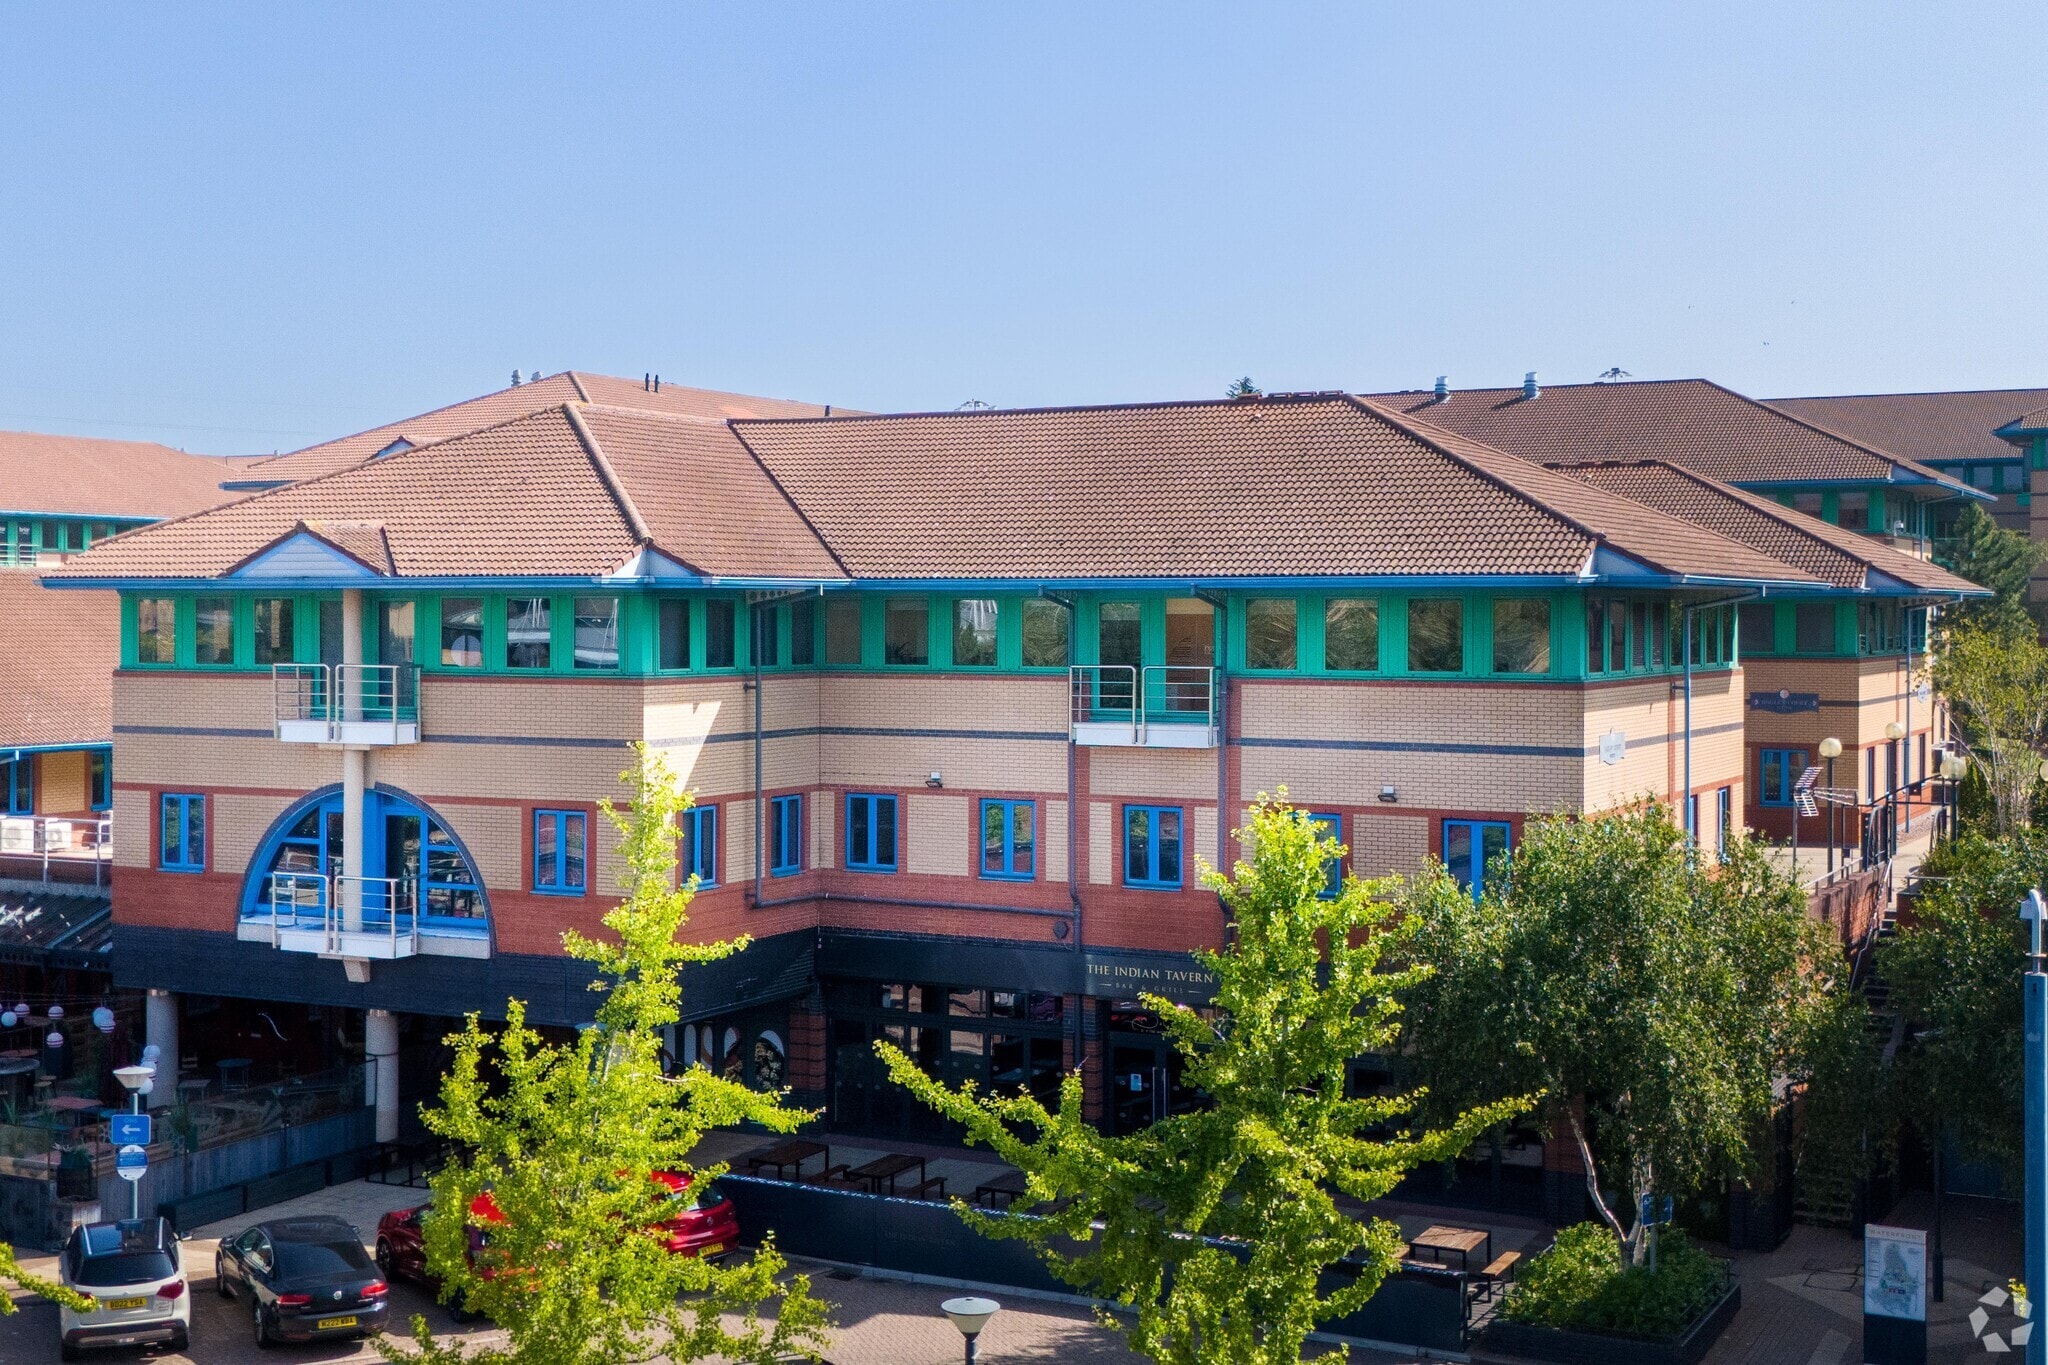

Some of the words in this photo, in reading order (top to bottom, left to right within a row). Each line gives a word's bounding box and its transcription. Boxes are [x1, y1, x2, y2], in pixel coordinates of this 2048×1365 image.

[1088, 964, 1110, 976] THE
[1114, 966, 1160, 979] INDIAN
[1165, 970, 1213, 984] TAVERN
[1115, 982, 1134, 990] BAR
[1154, 985, 1184, 994] GRILL
[1868, 1228, 1923, 1241] WATERFRONT
